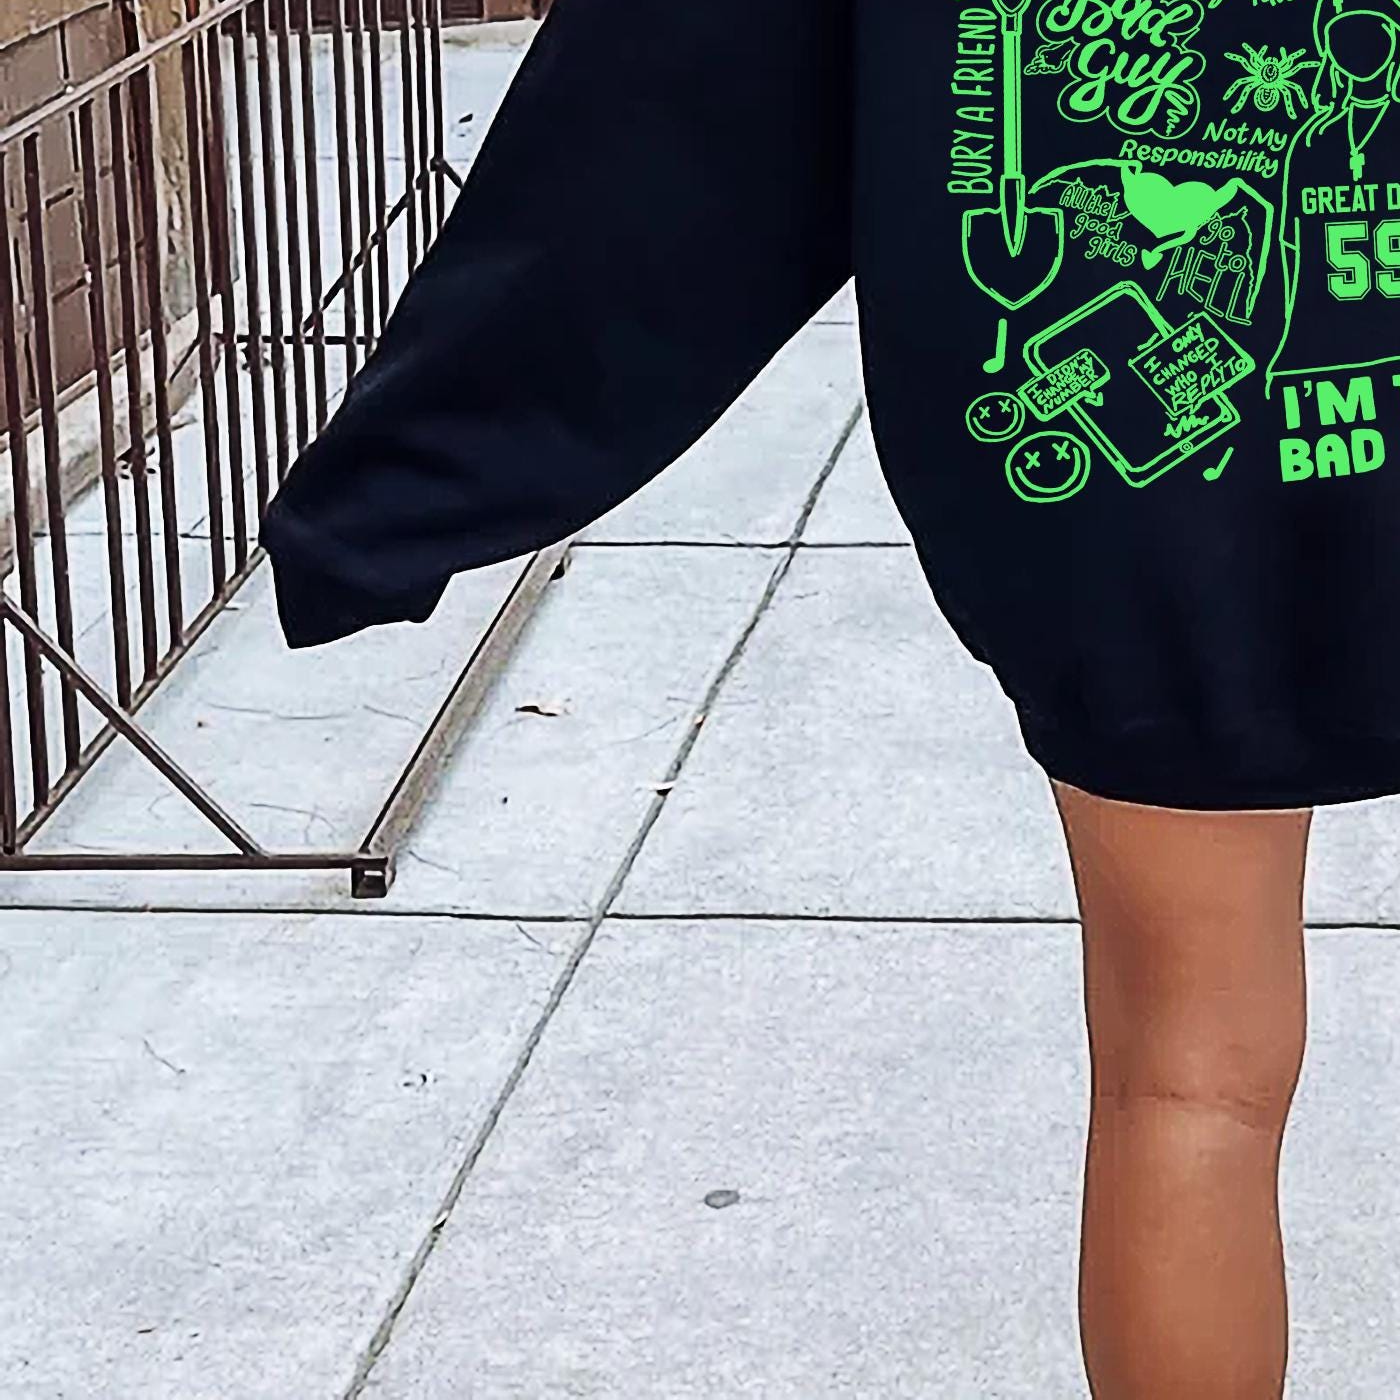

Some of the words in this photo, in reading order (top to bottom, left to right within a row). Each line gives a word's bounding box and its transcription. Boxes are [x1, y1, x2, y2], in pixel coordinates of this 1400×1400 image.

[950, 7, 997, 96] FRIEND
[956, 107, 995, 123] A
[1202, 118, 1250, 145] Not
[1249, 127, 1288, 152] My
[947, 129, 995, 194] BURY
[1119, 138, 1279, 178] Responsibility
[1059, 183, 1085, 210] All
[1083, 191, 1111, 216] the
[1301, 182, 1381, 215] GREAT
[1070, 212, 1124, 242] good
[1199, 218, 1236, 246] go
[1084, 236, 1138, 267] girls
[1214, 241, 1248, 273] to
[1155, 246, 1253, 326] HELL
[1143, 356, 1162, 373] I
[1171, 322, 1205, 353] ONLY
[1153, 337, 1219, 385] CHANGED
[1164, 370, 1198, 395] WHO
[1205, 352, 1223, 370] I
[1224, 356, 1247, 376] TO
[1026, 383, 1043, 400] I
[1036, 372, 1079, 405] CHANGE
[1043, 369, 1099, 414] NUMBER
[1282, 375, 1377, 430] I'M
[1279, 428, 1386, 483] BAD
